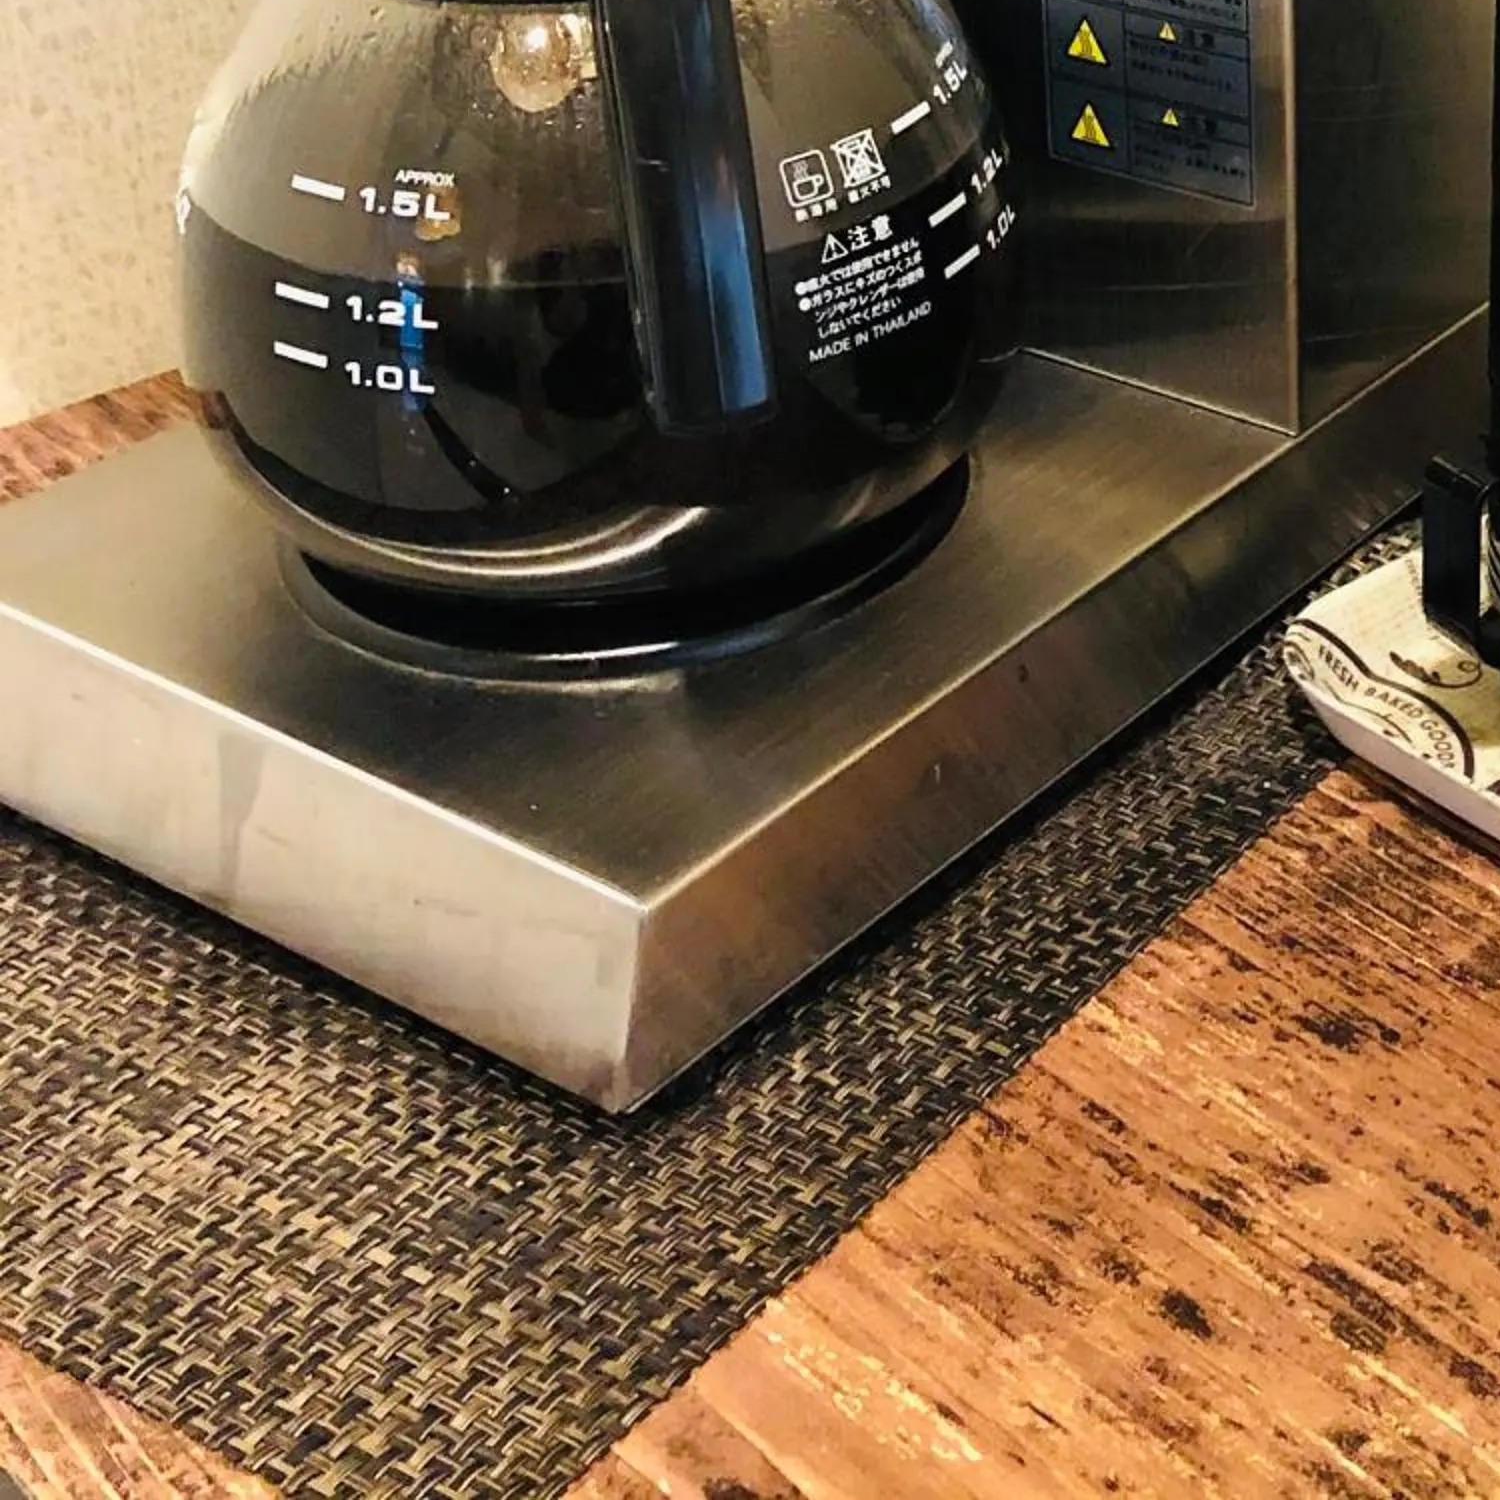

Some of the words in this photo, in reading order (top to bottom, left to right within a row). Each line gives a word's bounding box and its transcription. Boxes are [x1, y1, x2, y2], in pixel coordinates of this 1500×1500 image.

[394, 169, 457, 187] APPROX
[847, 213, 894, 252] 注意
[808, 339, 857, 363] MADE
[854, 329, 870, 348] IN
[872, 301, 933, 341] THAILAND
[1364, 685, 1424, 721] BAKED
